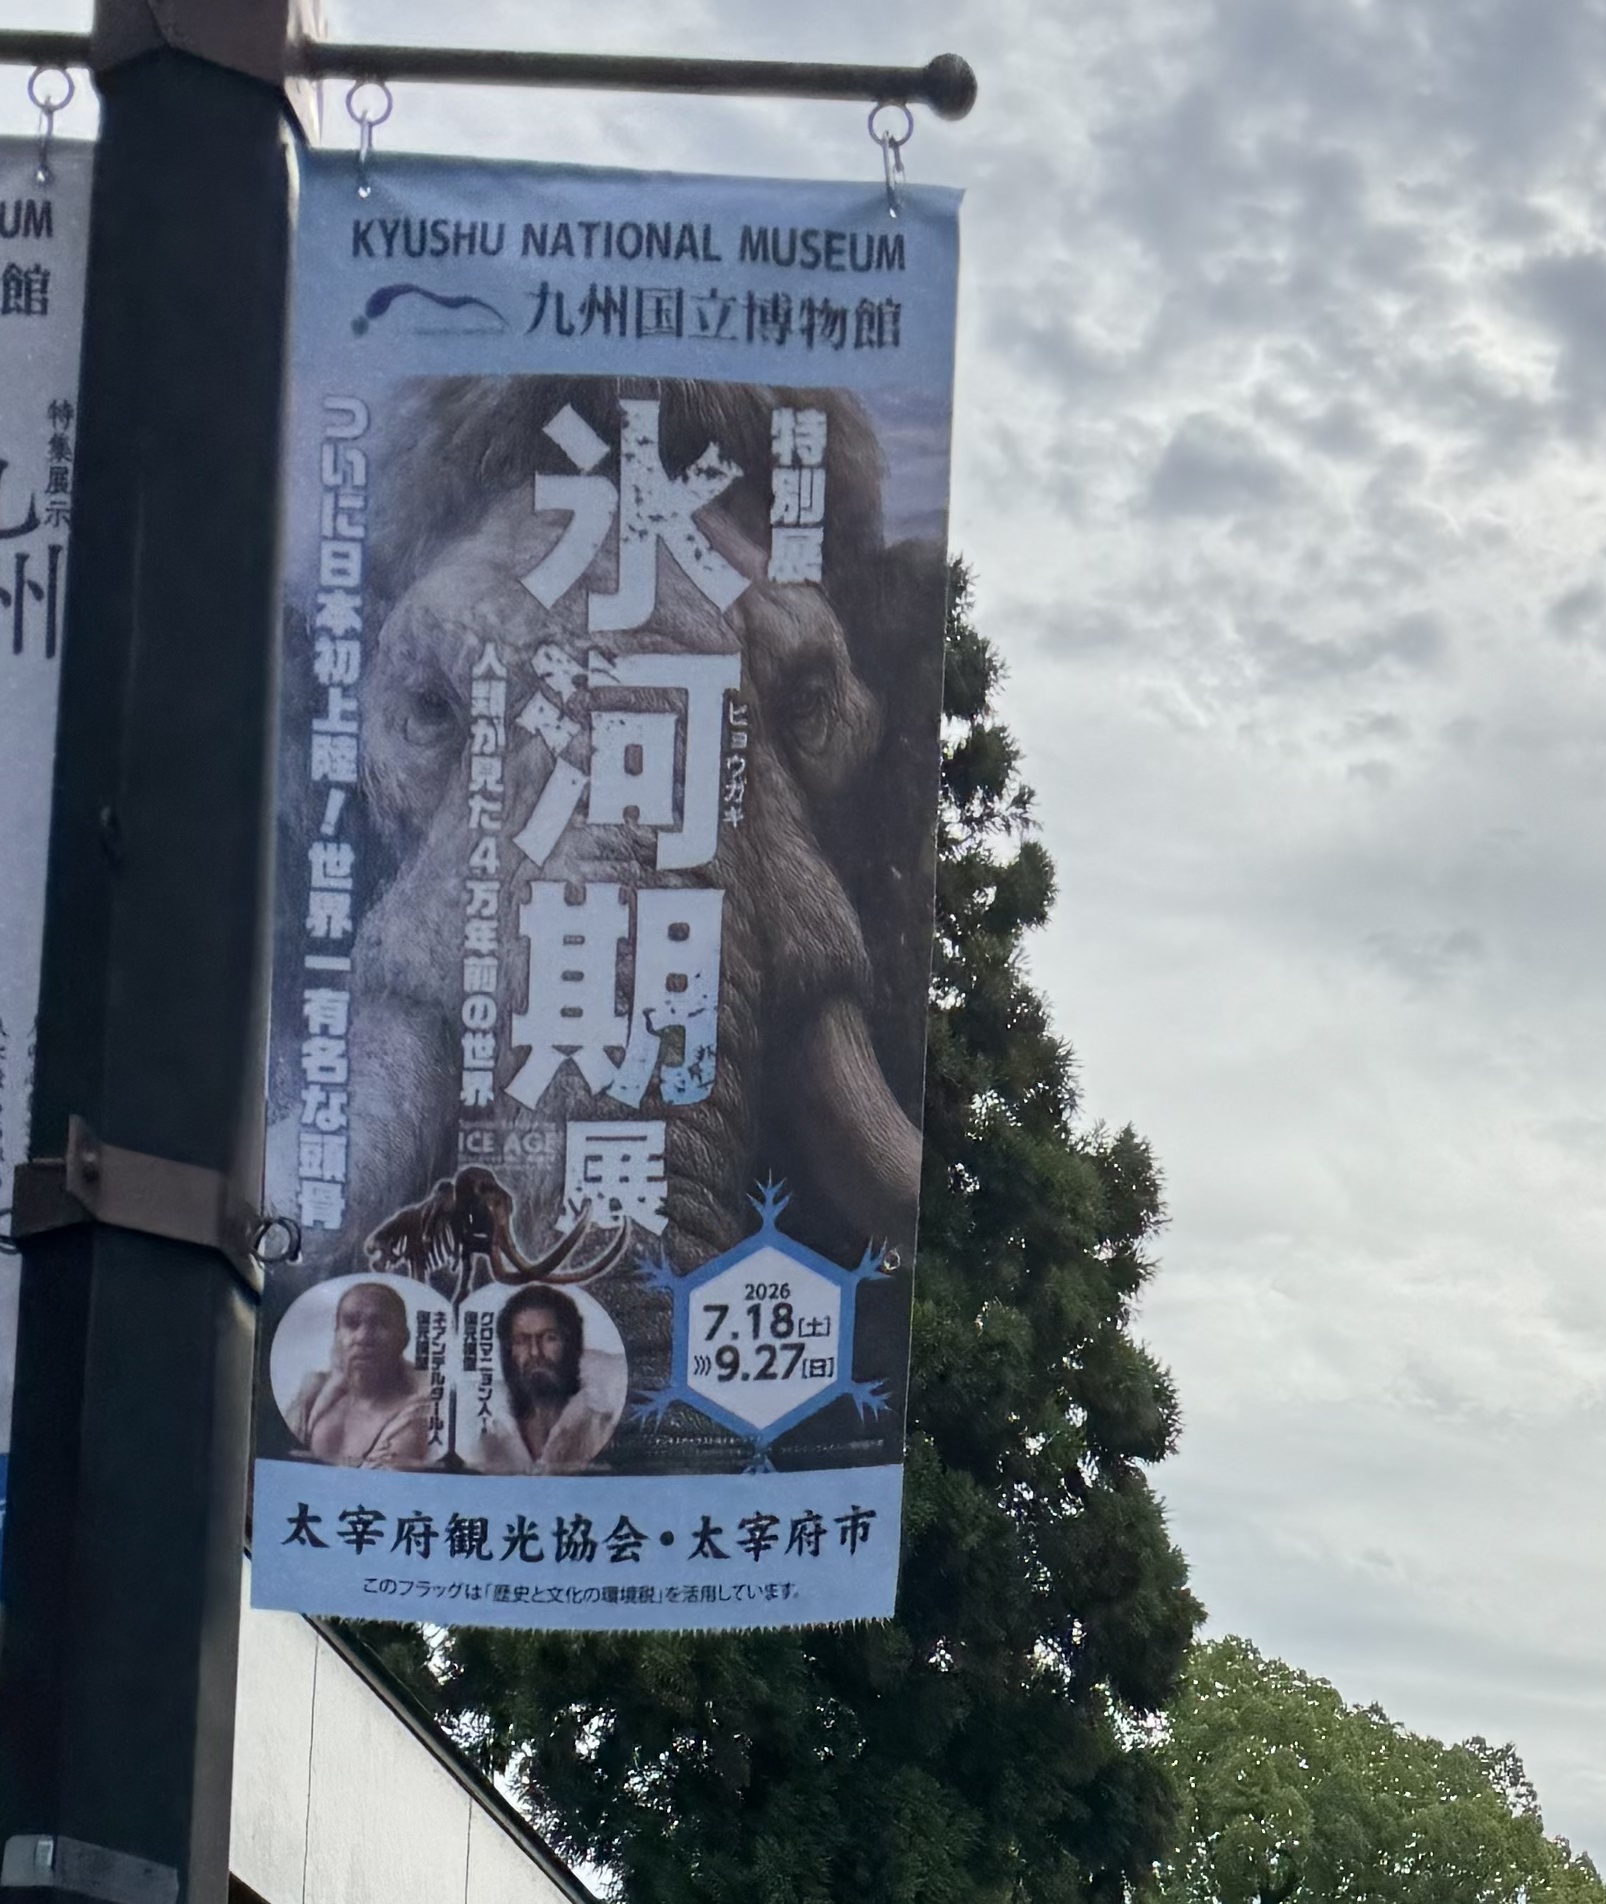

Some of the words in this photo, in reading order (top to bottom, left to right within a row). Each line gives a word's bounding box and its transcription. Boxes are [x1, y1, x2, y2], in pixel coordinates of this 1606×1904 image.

[351, 218, 505, 258] KYUSHU
[520, 221, 723, 262] NATIONAL
[739, 224, 907, 272] MUSEUM
[523, 281, 902, 350] 九州国立博物館
[45, 399, 74, 529] 特集展示
[768, 406, 827, 584] 特別展
[457, 1131, 494, 1153] ICE
[744, 1282, 791, 1301] 2026
[281, 1501, 877, 1564] 太宰府観光協会・太宰府市
